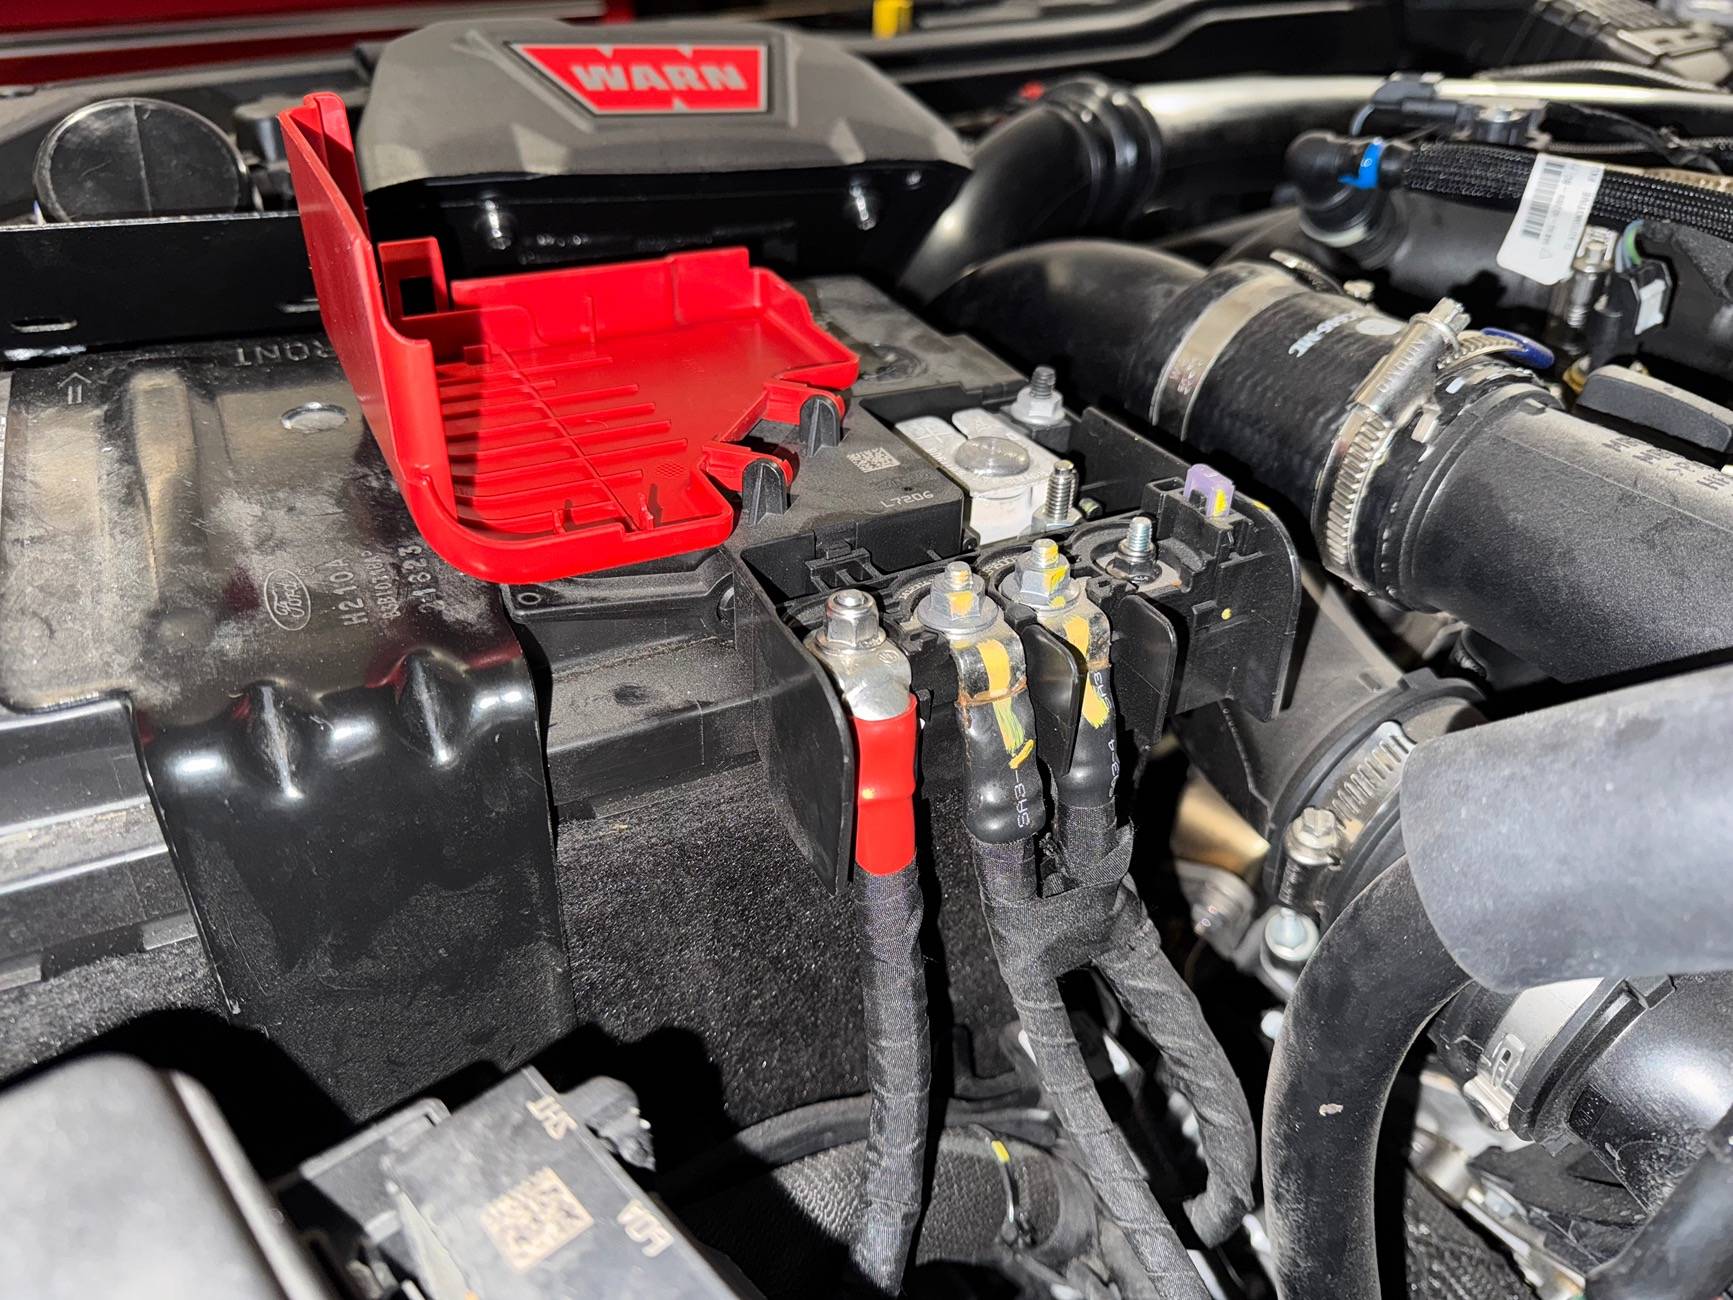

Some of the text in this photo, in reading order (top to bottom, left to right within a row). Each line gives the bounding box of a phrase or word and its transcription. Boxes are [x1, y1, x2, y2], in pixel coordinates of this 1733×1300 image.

[569, 63, 748, 91] WARN
[880, 490, 935, 508] L7206
[271, 580, 305, 618] Ford
[1014, 769, 1030, 828] SA3-
